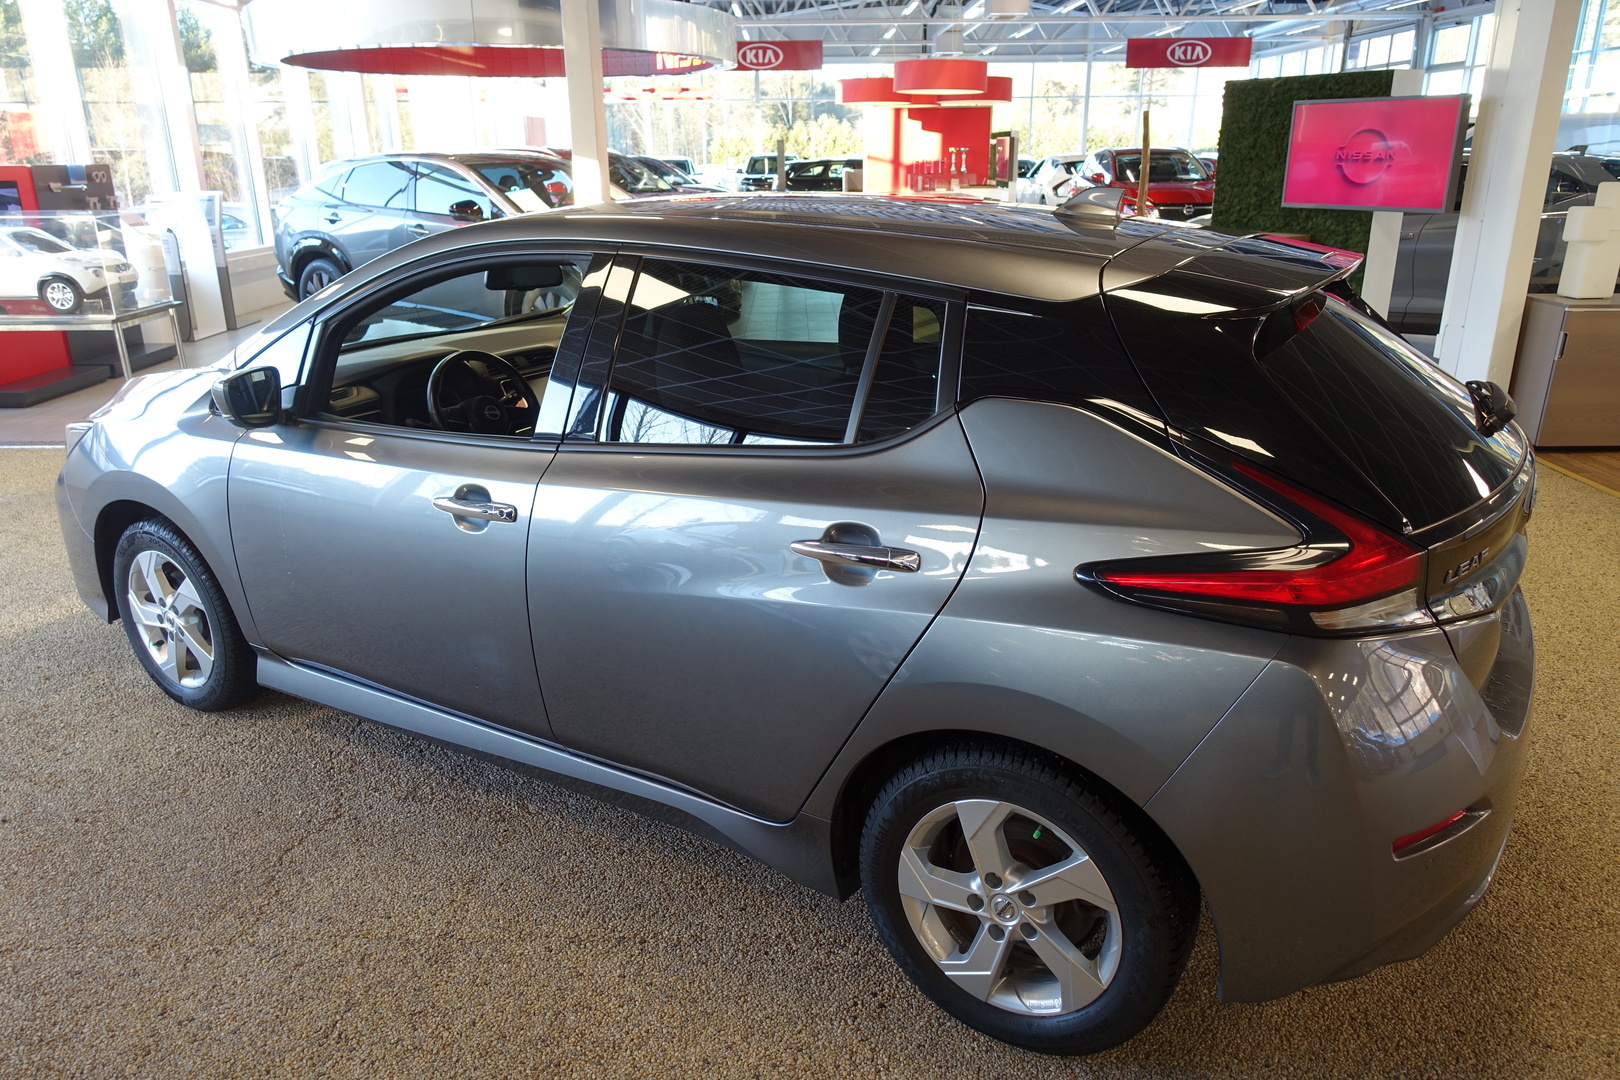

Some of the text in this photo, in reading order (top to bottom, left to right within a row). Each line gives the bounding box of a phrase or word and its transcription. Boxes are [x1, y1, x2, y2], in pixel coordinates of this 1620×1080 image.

[745, 49, 776, 64] KIA
[1174, 45, 1204, 60] KIA
[1335, 150, 1396, 161] NISSAN
[1443, 547, 1490, 584] LEAF
